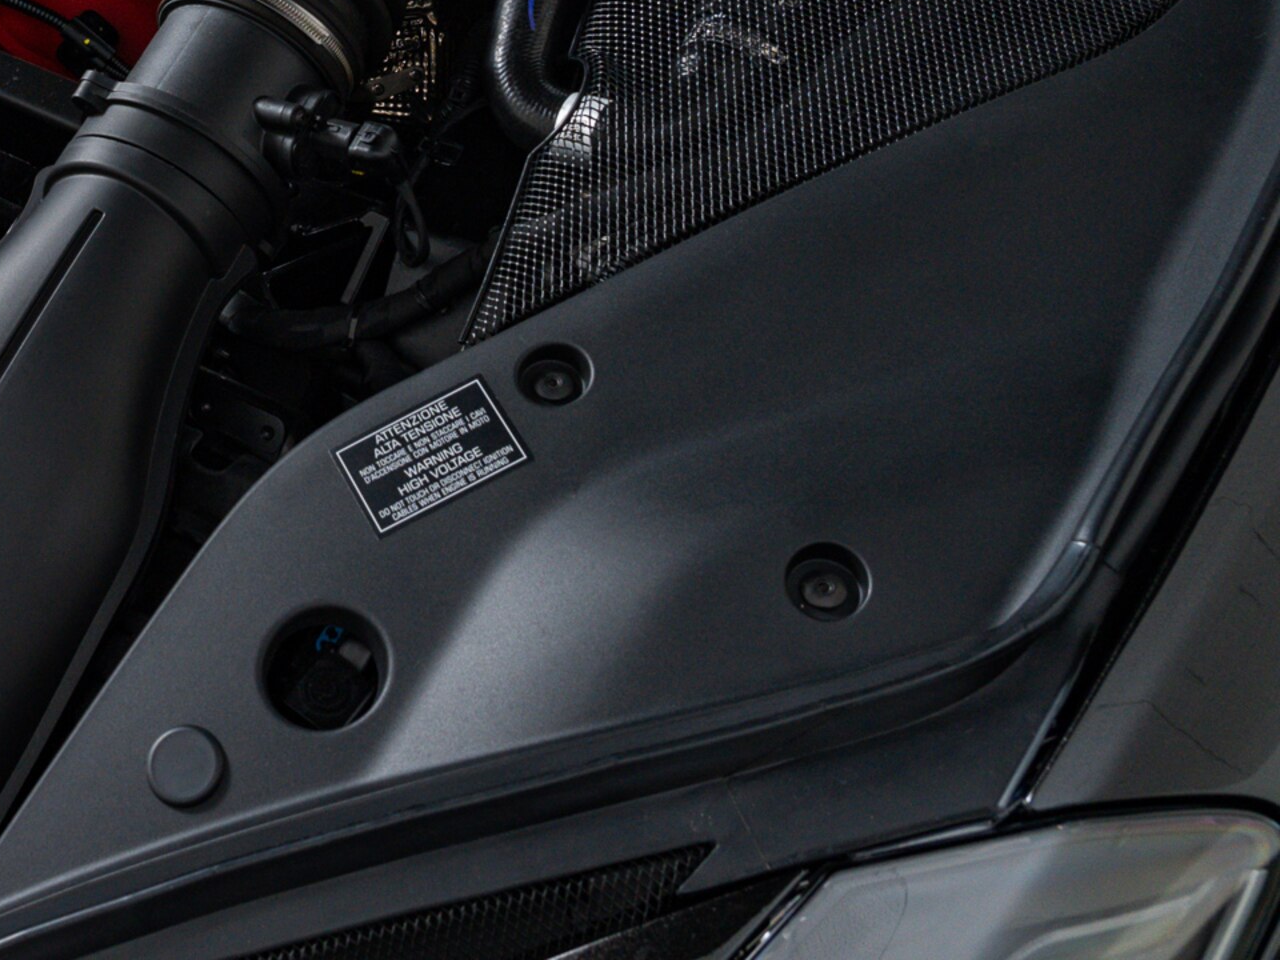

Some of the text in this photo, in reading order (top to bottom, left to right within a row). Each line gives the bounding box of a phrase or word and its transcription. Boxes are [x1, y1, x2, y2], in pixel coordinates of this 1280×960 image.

[359, 464, 375, 477] NON
[377, 448, 406, 467] TOCCARE
[414, 436, 429, 448] NON
[431, 418, 464, 439] STACCARE
[470, 407, 486, 419] CAVI
[364, 414, 490, 483] D'ACCENSIONE CON MOTORE IN MOTO
[372, 406, 462, 458] ALTA TENSIONE
[374, 400, 449, 444] ATTENZIONE
[379, 444, 513, 518] DO NOT TOUCH OR DISCONNECT IGNITION
[392, 456, 509, 520] CABLES WHEN ENGINE IS RUNNING
[398, 446, 483, 495] HIGH VOLTAGE
[405, 442, 463, 478] WARNING
